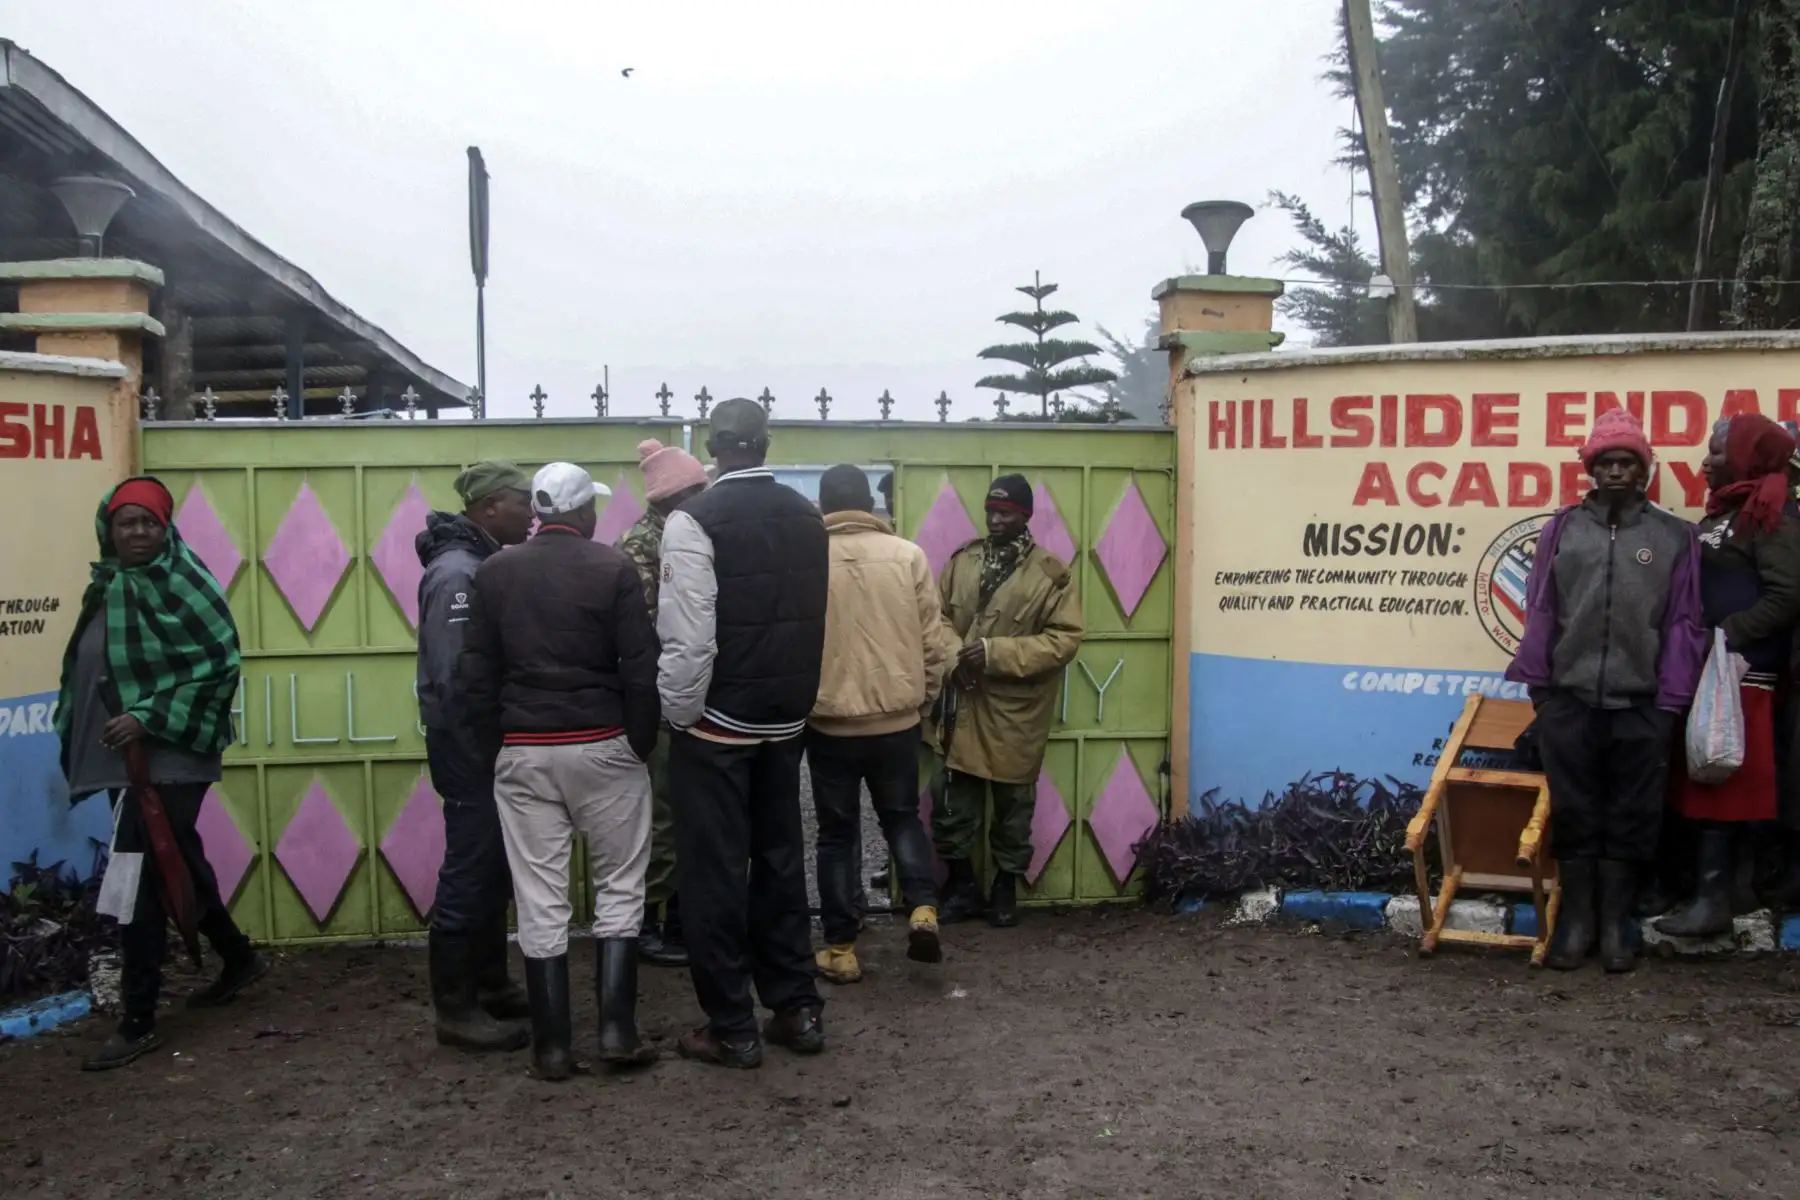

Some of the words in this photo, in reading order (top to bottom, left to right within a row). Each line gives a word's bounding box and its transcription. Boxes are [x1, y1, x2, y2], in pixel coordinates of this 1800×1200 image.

[1208, 393, 1520, 450] HILLSIDE
[1303, 522, 1466, 557] MISSION:
[1214, 568, 1292, 586] EMPOWERING
[1295, 568, 1317, 584] THE
[1317, 568, 1397, 586] COMMUNITY
[1400, 570, 1469, 588] THROUGH
[1219, 595, 1267, 613] QUALITY
[1267, 595, 1295, 611] AND
[1300, 595, 1374, 612] PRACTICAL
[1378, 597, 1469, 616] EDUCATION.
